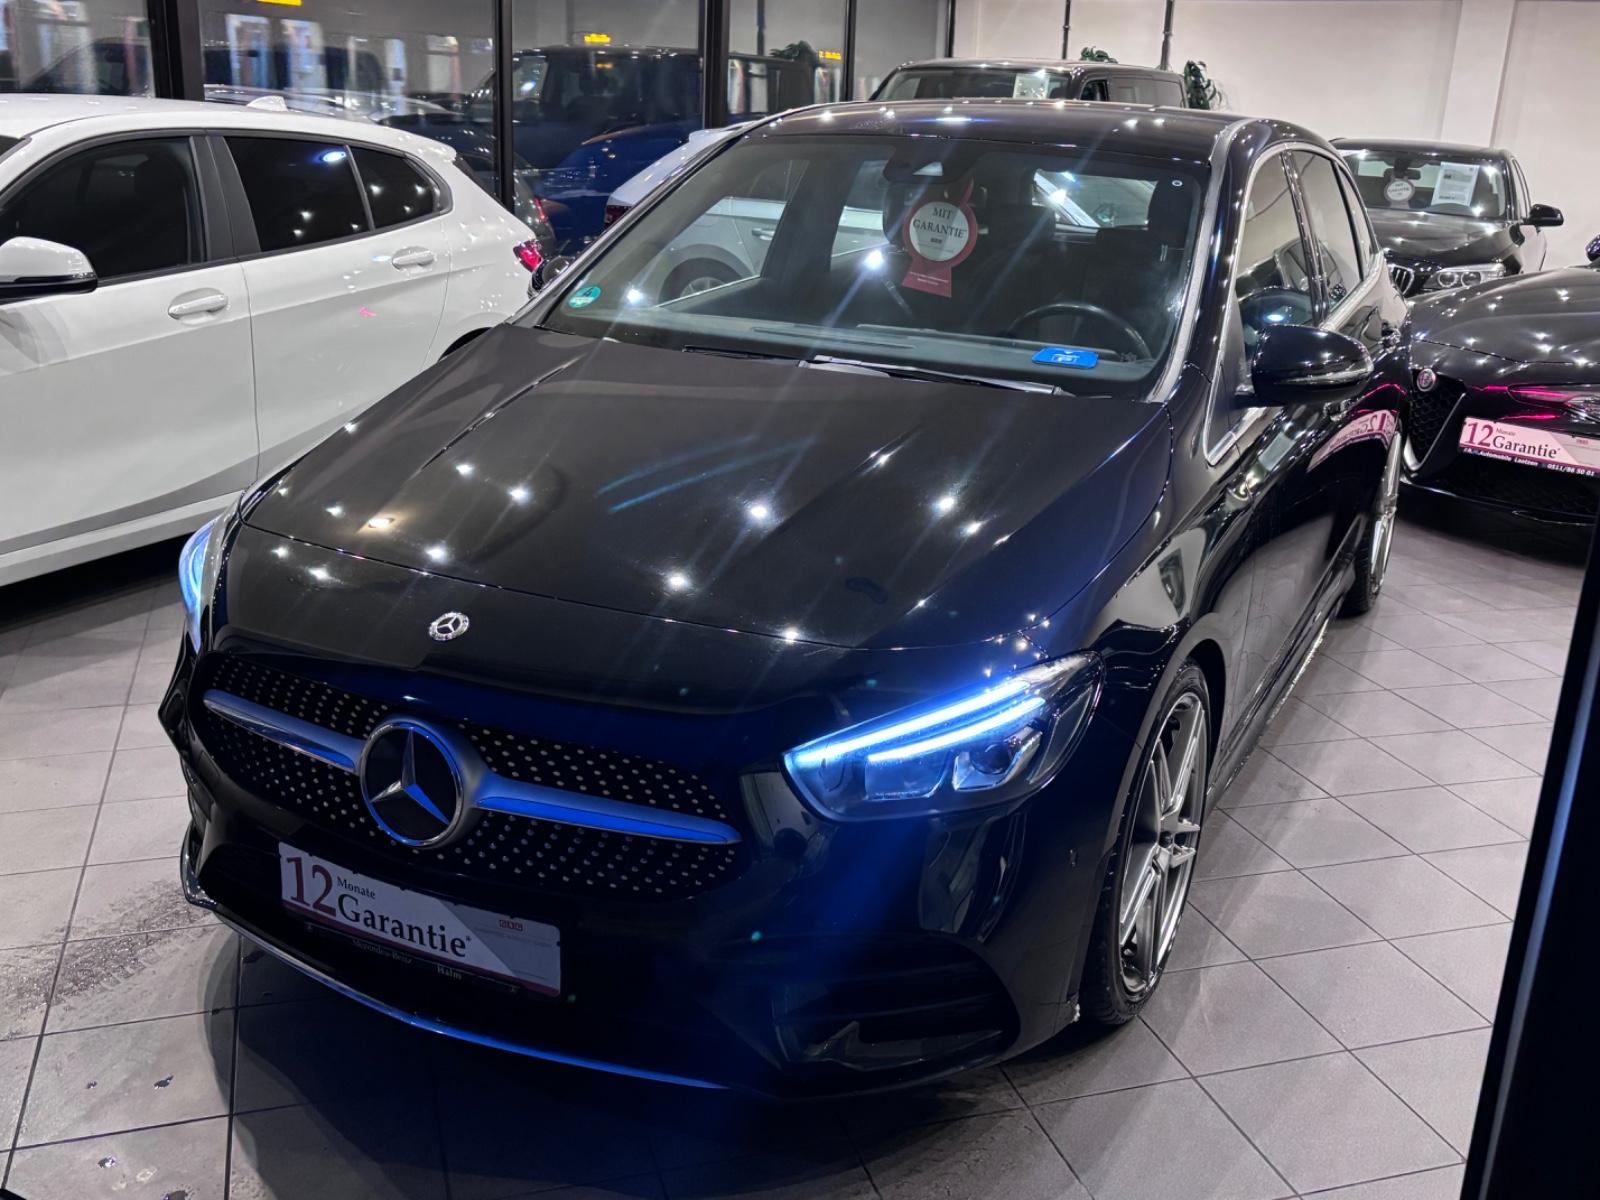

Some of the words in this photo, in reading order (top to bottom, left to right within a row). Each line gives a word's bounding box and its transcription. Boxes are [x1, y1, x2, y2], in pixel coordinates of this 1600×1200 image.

[933, 207, 952, 219] MIT
[1464, 422, 1493, 447] 12
[287, 857, 336, 917] 12
[337, 876, 376, 899] Monate
